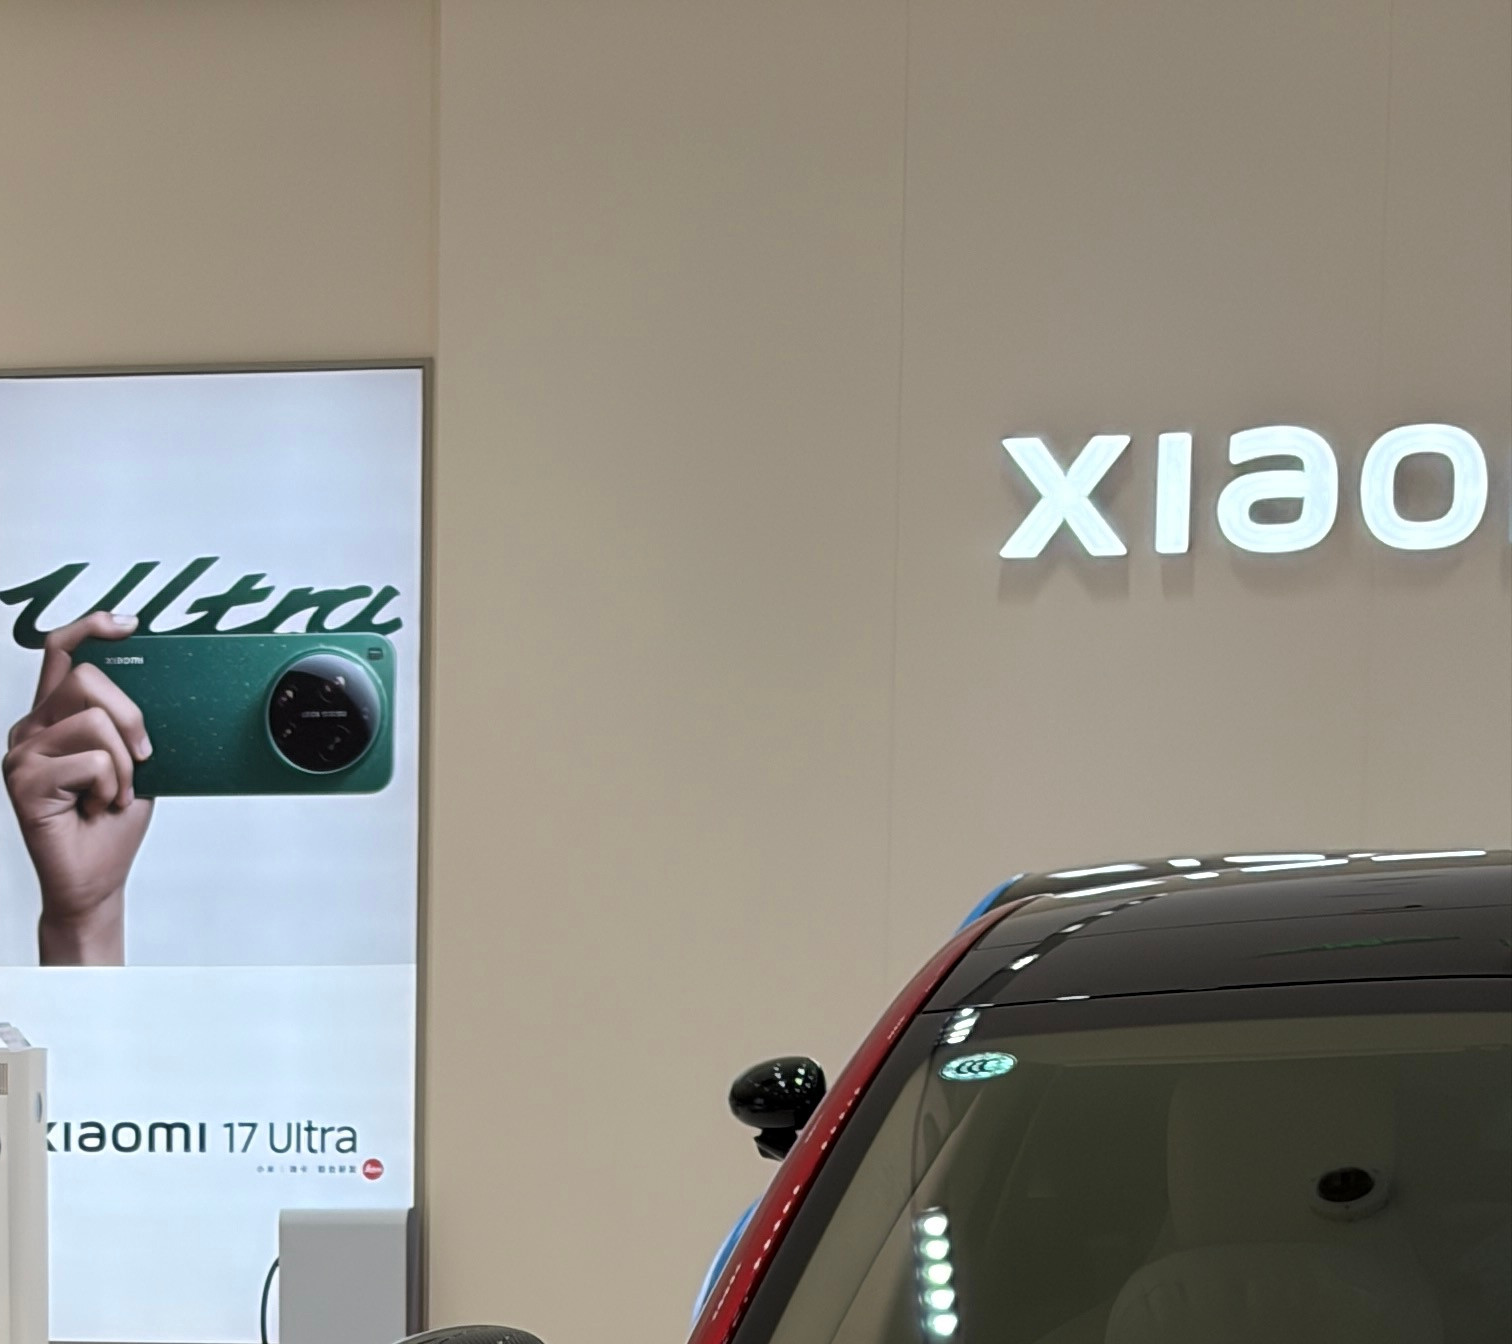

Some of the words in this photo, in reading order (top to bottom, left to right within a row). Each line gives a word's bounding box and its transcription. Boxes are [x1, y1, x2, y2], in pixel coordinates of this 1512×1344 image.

[999, 423, 1512, 559] xiao
[223, 1122, 258, 1153] 17
[268, 1119, 358, 1154] Ultra
